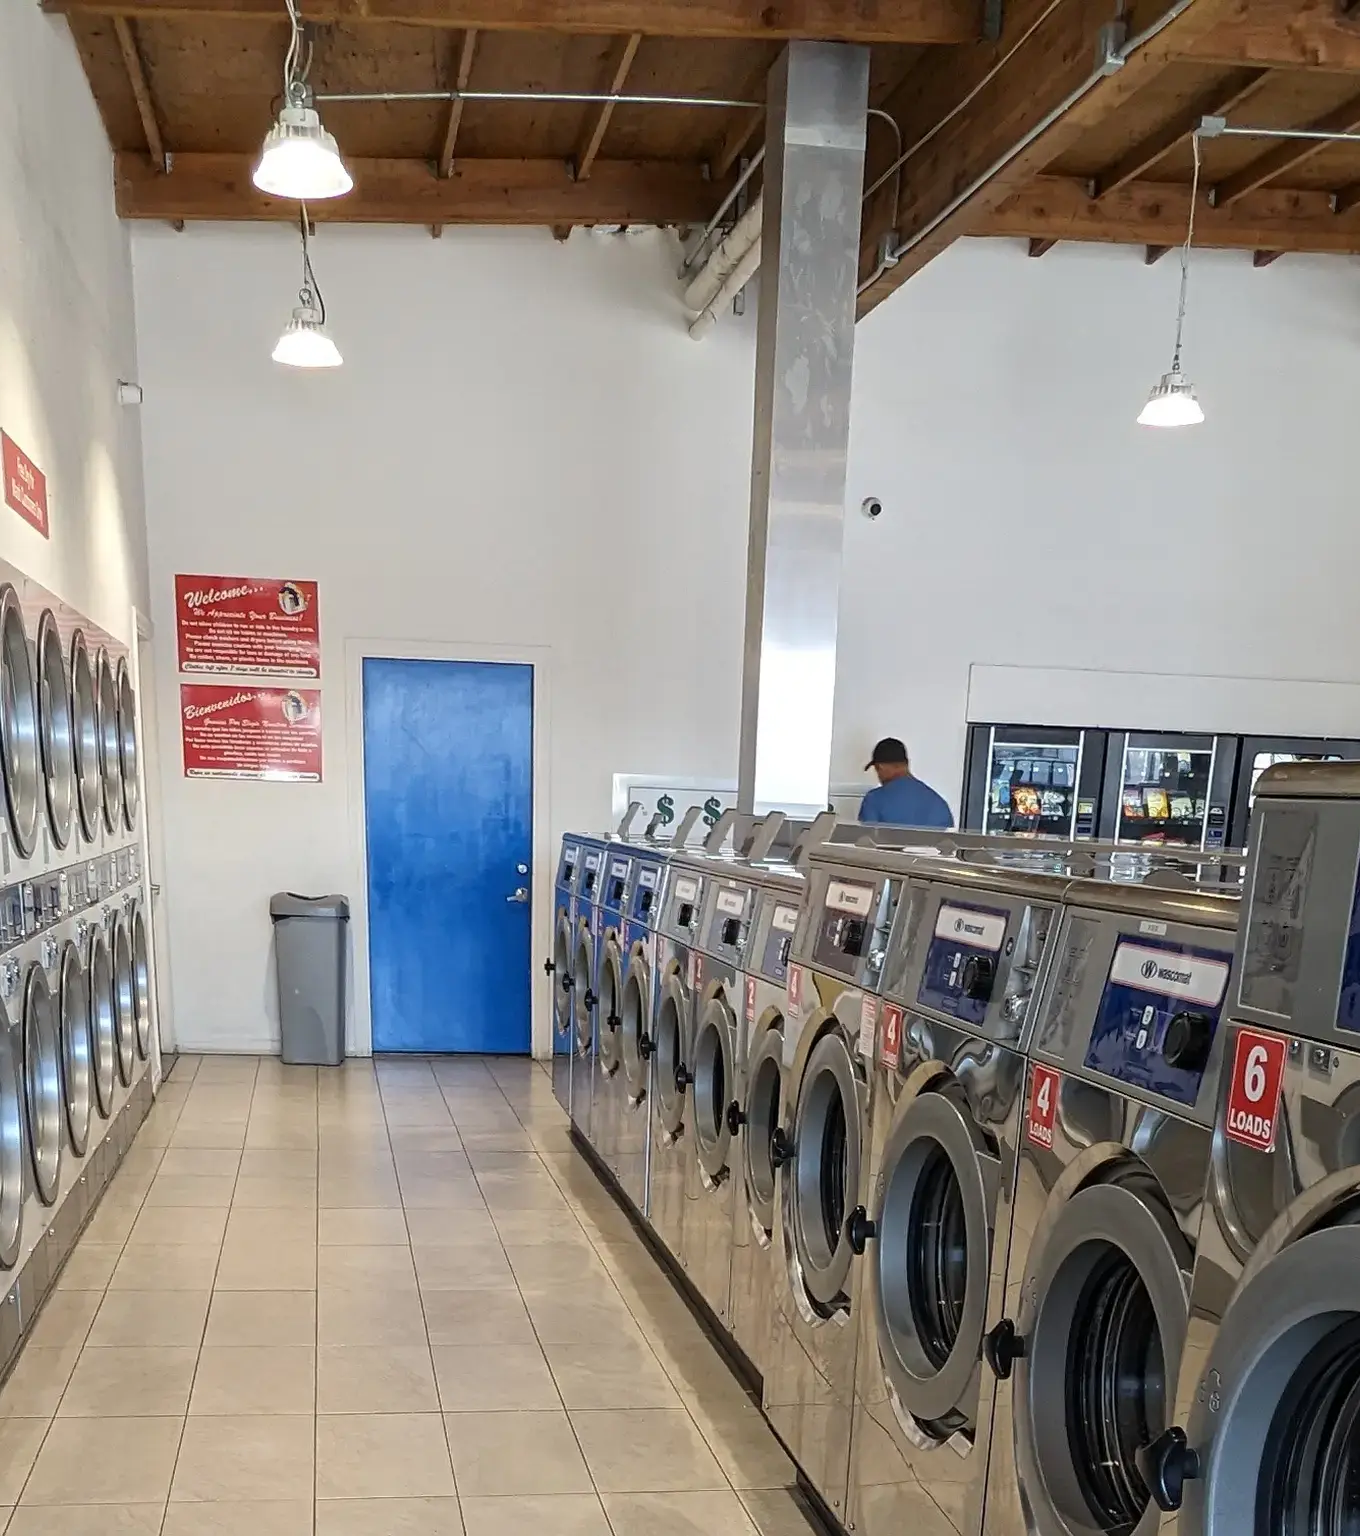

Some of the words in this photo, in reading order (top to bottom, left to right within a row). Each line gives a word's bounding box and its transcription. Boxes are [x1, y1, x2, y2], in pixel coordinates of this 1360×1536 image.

[1244, 1046, 1268, 1102] 6
[1037, 1077, 1051, 1117] 4
[1030, 1120, 1052, 1143] LOADS
[1228, 1108, 1271, 1140] LOADS
